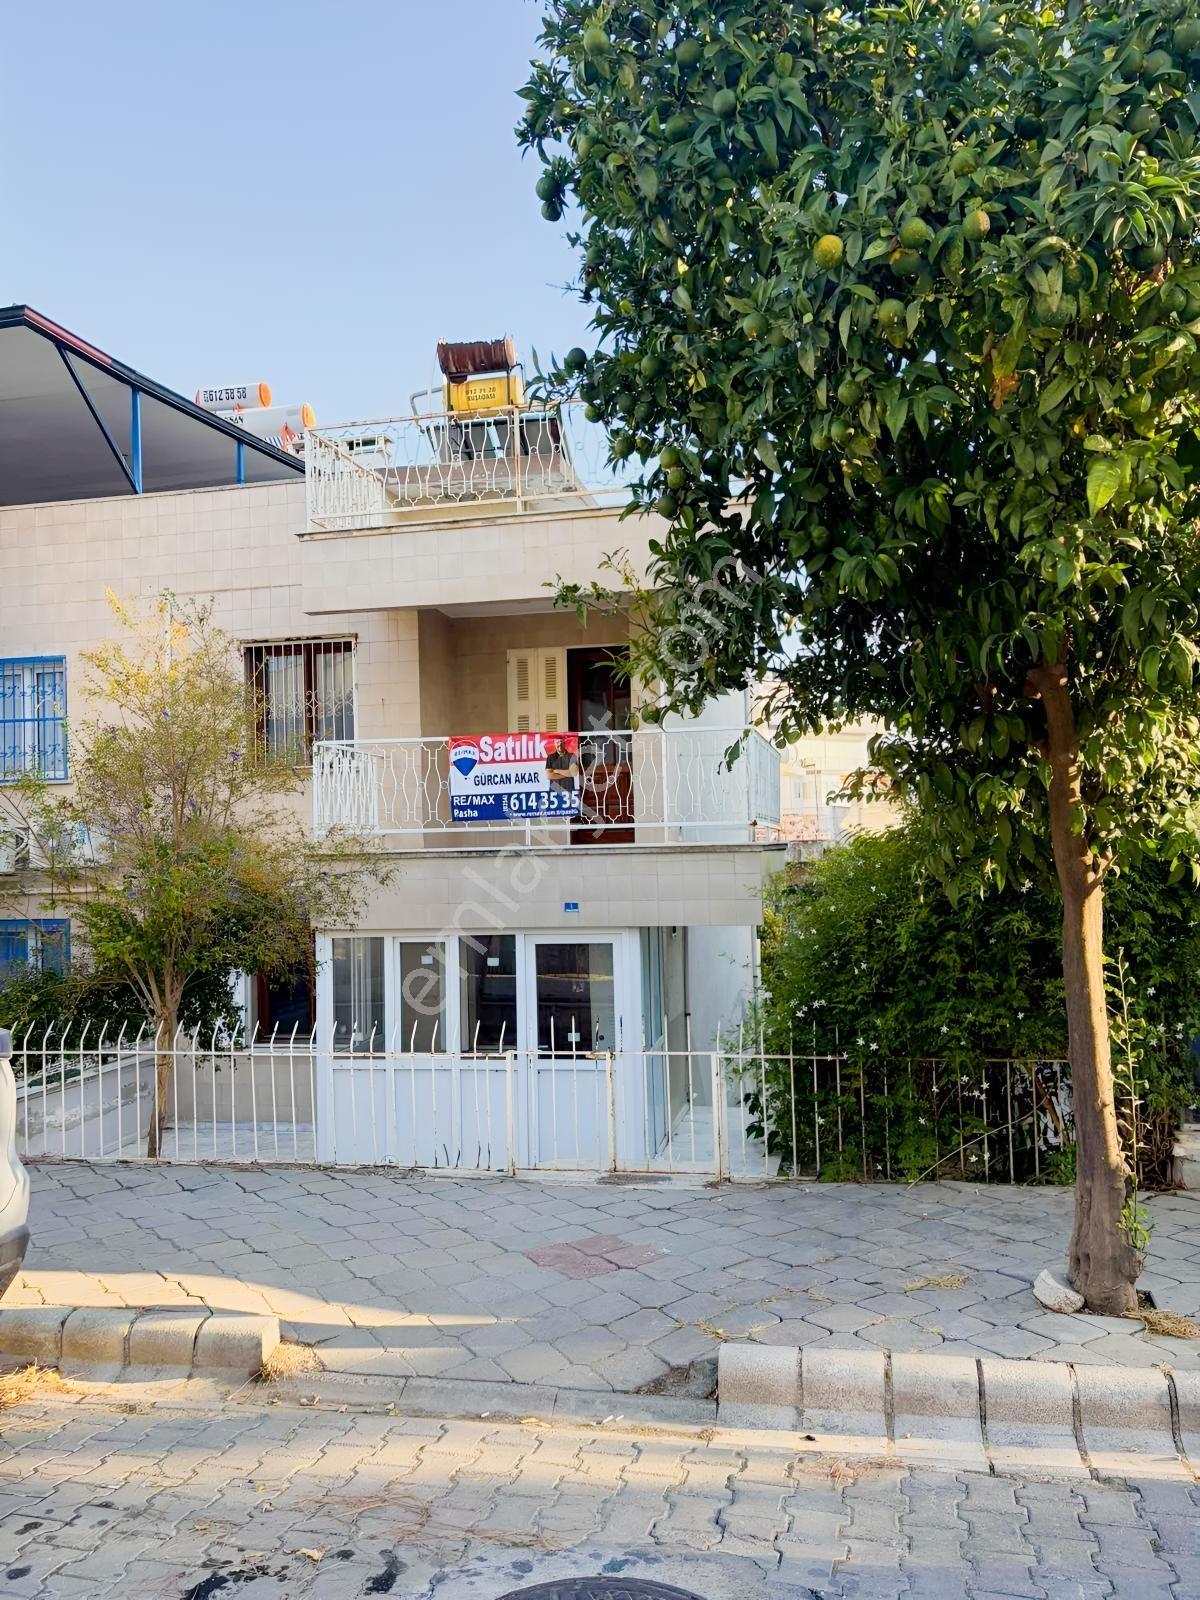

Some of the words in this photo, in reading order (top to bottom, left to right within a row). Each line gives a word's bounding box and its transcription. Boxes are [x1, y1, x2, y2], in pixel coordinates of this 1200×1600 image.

[208, 389, 224, 402] 612
[225, 388, 235, 401] 58
[236, 387, 247, 400] 58
[480, 734, 548, 762] Satılık
[474, 772, 512, 786] GÜRCAN
[514, 772, 540, 784] AKAR
[453, 795, 495, 806] RE/MAX
[510, 792, 538, 811] 614
[540, 791, 559, 809] 35
[561, 790, 580, 809] 35
[453, 808, 479, 818] Pasha
